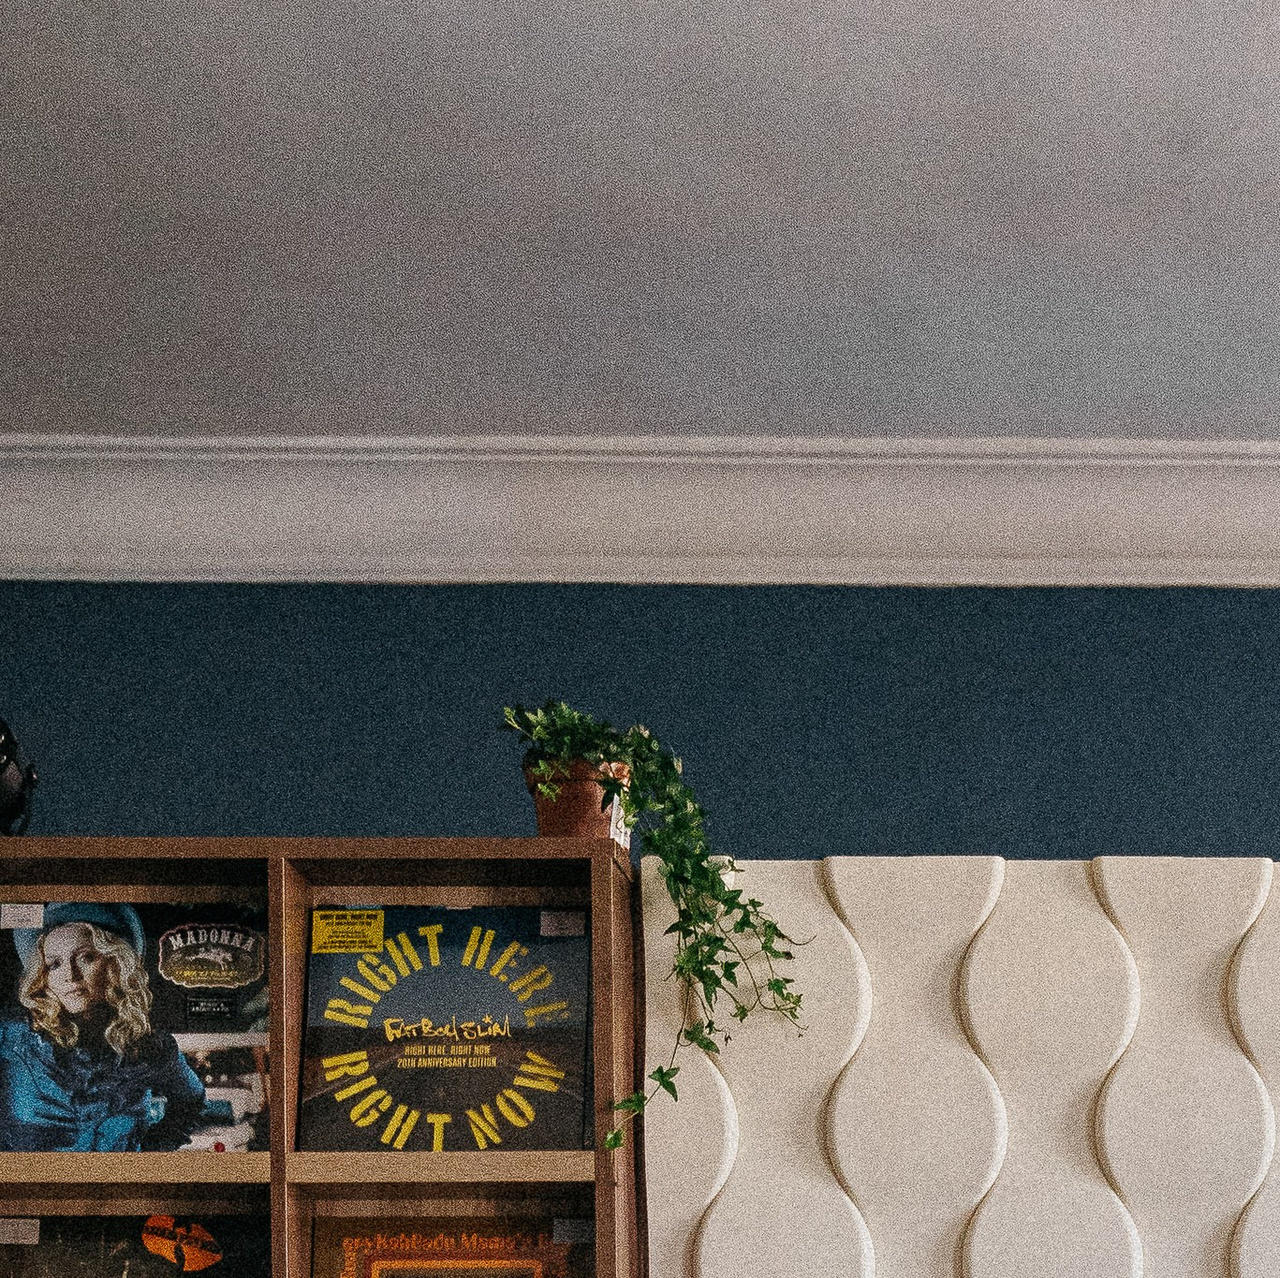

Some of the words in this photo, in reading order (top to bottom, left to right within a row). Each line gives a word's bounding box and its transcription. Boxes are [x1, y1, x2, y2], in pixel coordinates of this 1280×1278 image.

[168, 929, 255, 952] MADONNA
[324, 924, 443, 1028] RIGHT
[417, 1057, 466, 1068] ANNIVERSARY
[322, 1051, 452, 1152] RIGHT
[466, 1050, 566, 1150] NOW
